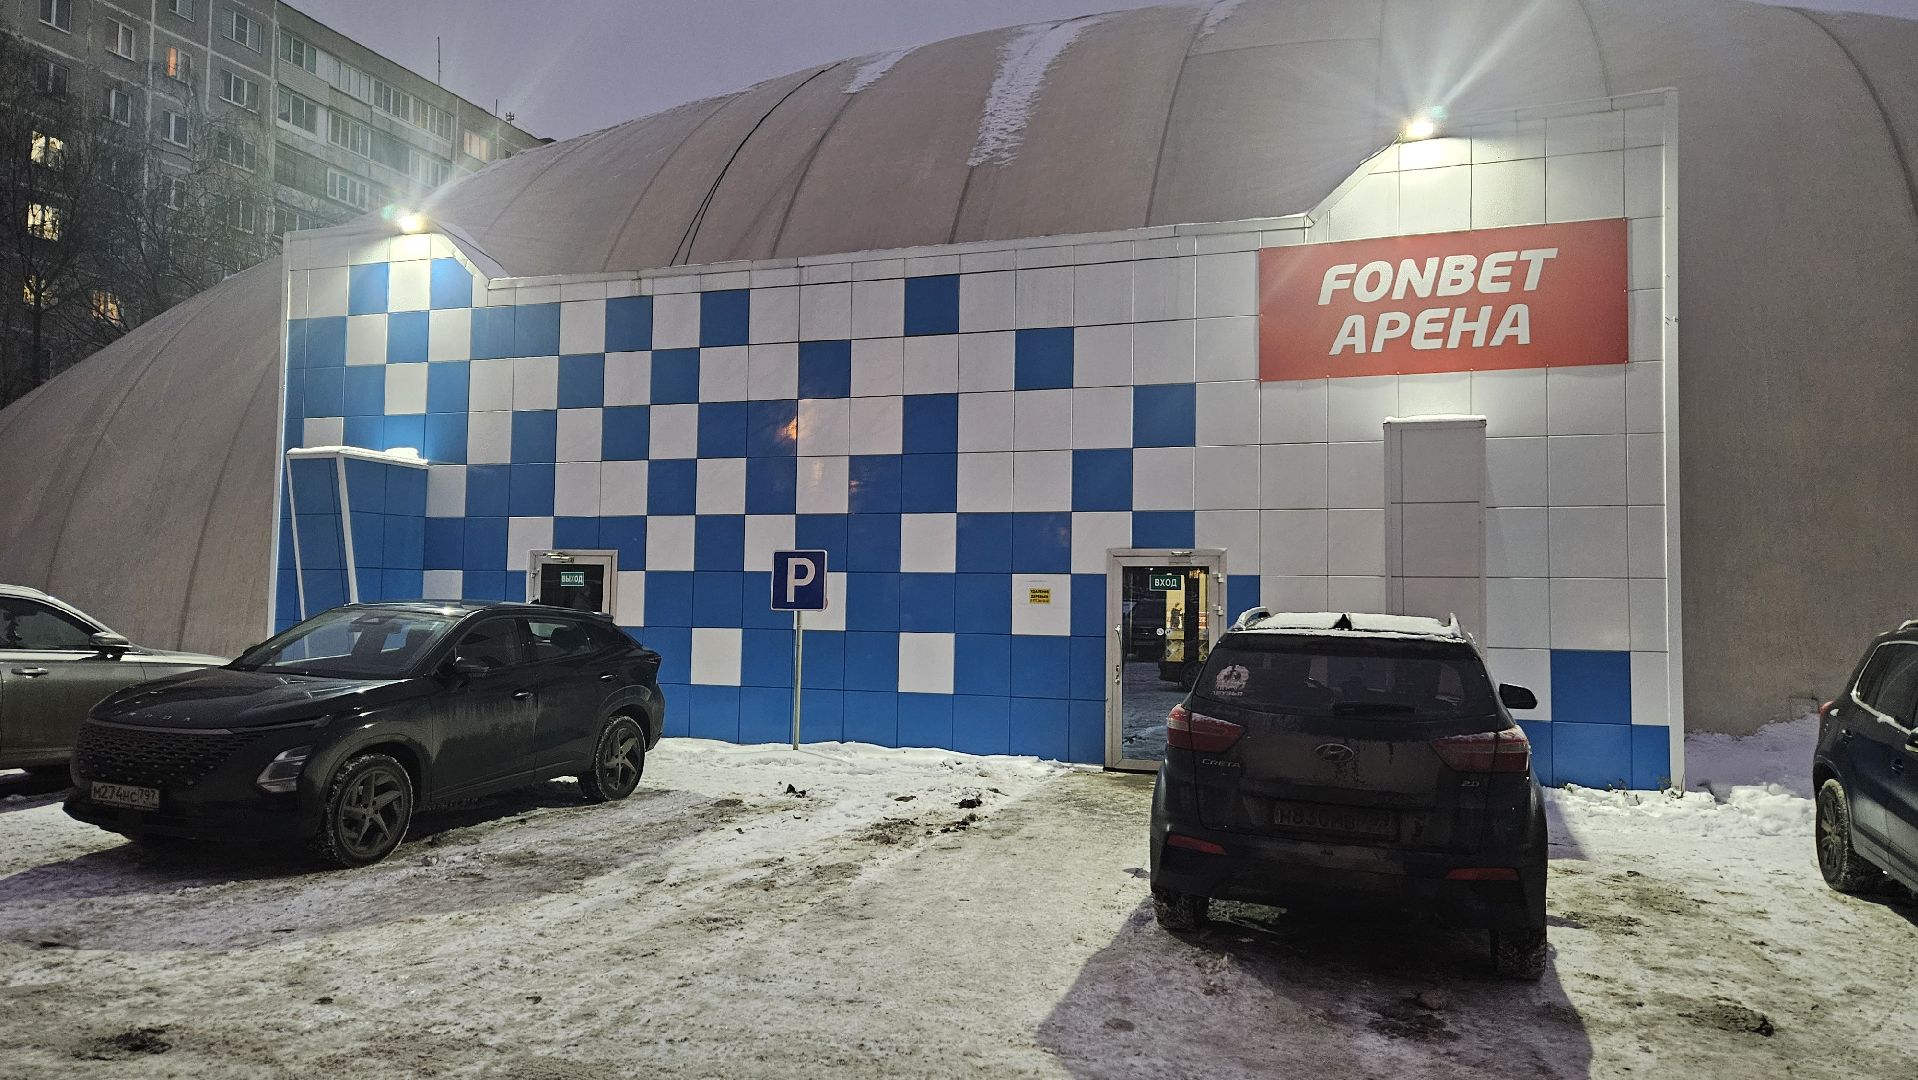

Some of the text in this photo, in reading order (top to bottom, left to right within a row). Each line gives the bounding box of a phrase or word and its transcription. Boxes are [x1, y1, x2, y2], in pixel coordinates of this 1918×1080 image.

[1317, 247, 1559, 305] FONBET
[1328, 303, 1531, 355] АРЕНА
[561, 575, 583, 584] ВЫХОД
[786, 557, 816, 603] P
[1154, 579, 1178, 587] ВХОД
[1202, 758, 1241, 768] CRETA
